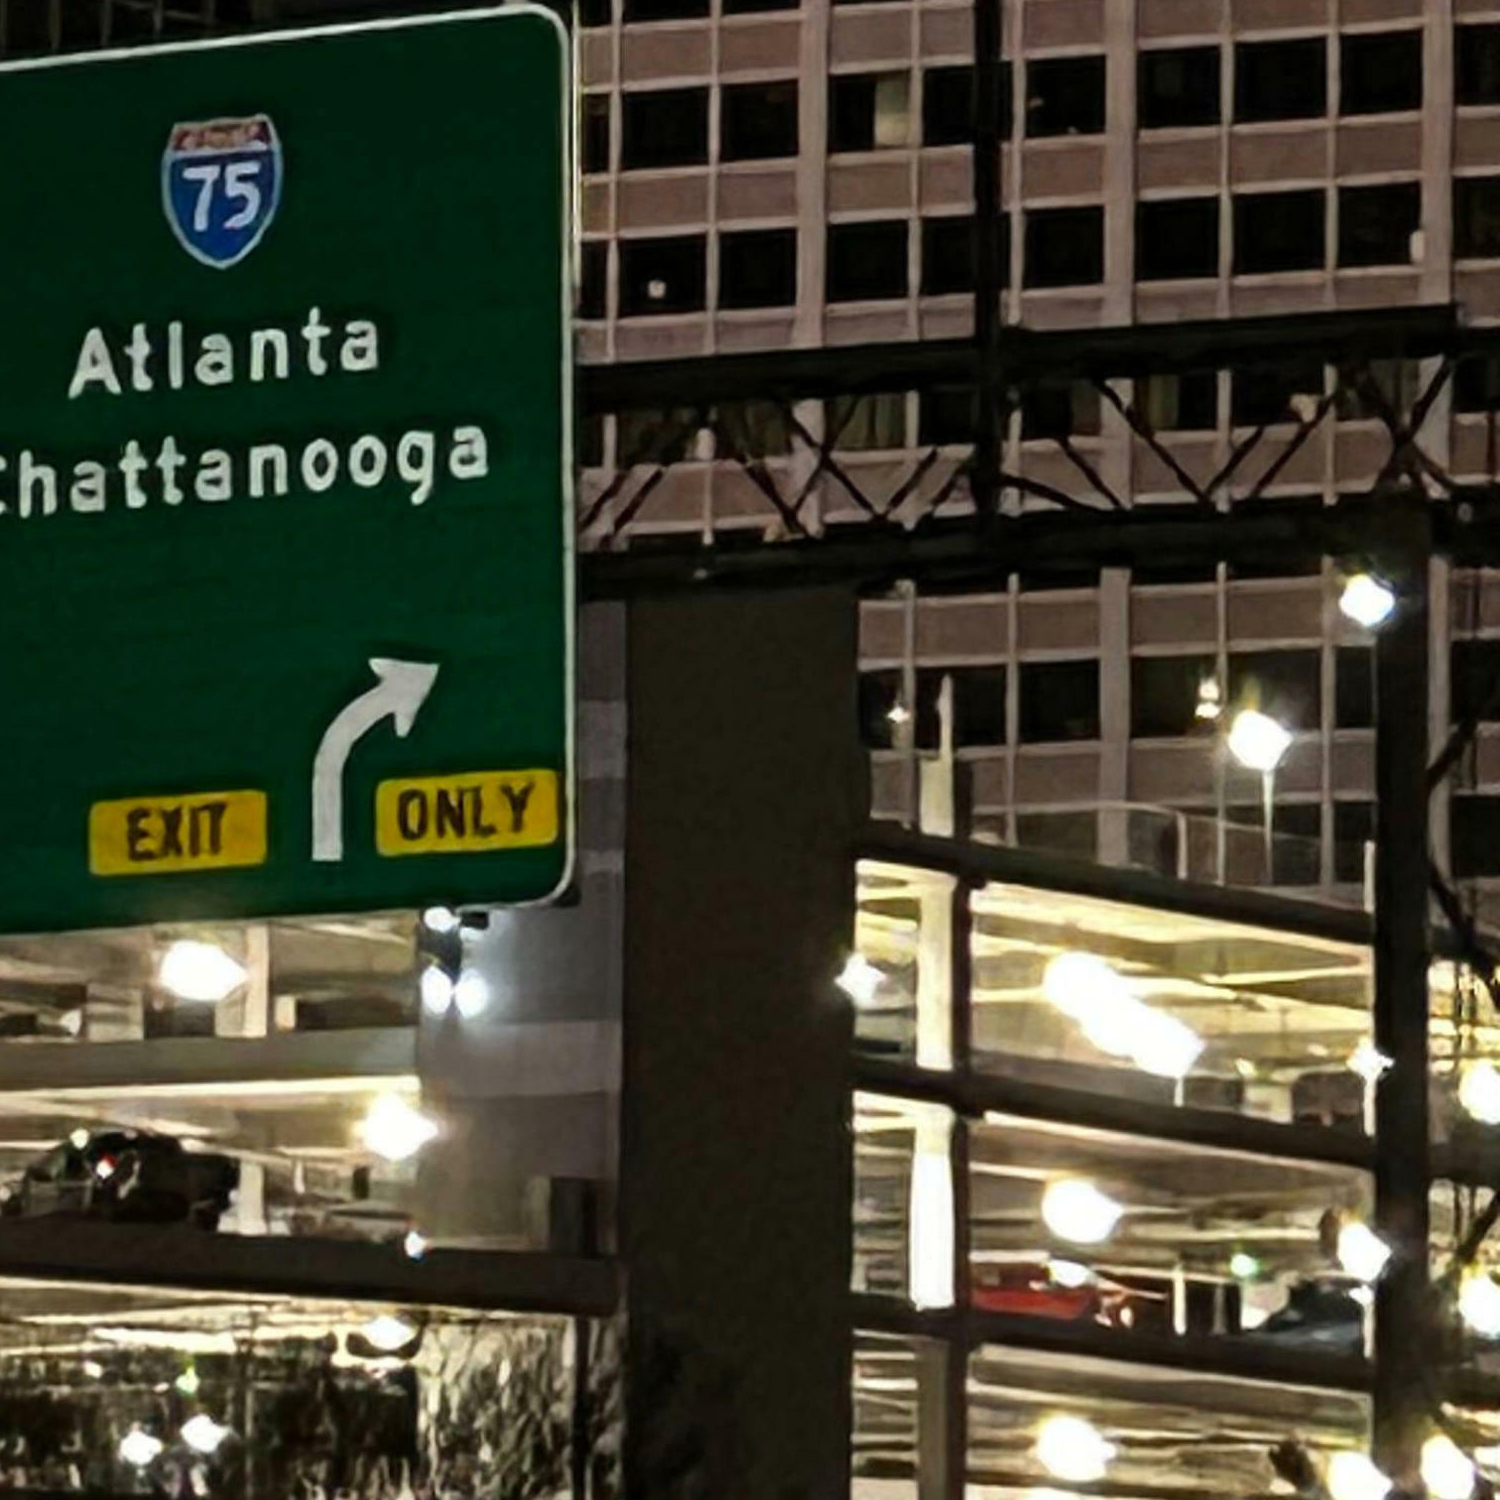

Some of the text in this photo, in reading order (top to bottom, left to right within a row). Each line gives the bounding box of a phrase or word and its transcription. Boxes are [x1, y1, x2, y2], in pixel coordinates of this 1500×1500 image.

[182, 160, 262, 233] 75
[67, 306, 380, 400] Atlanta
[125, 775, 536, 863] EXIT ONLY
